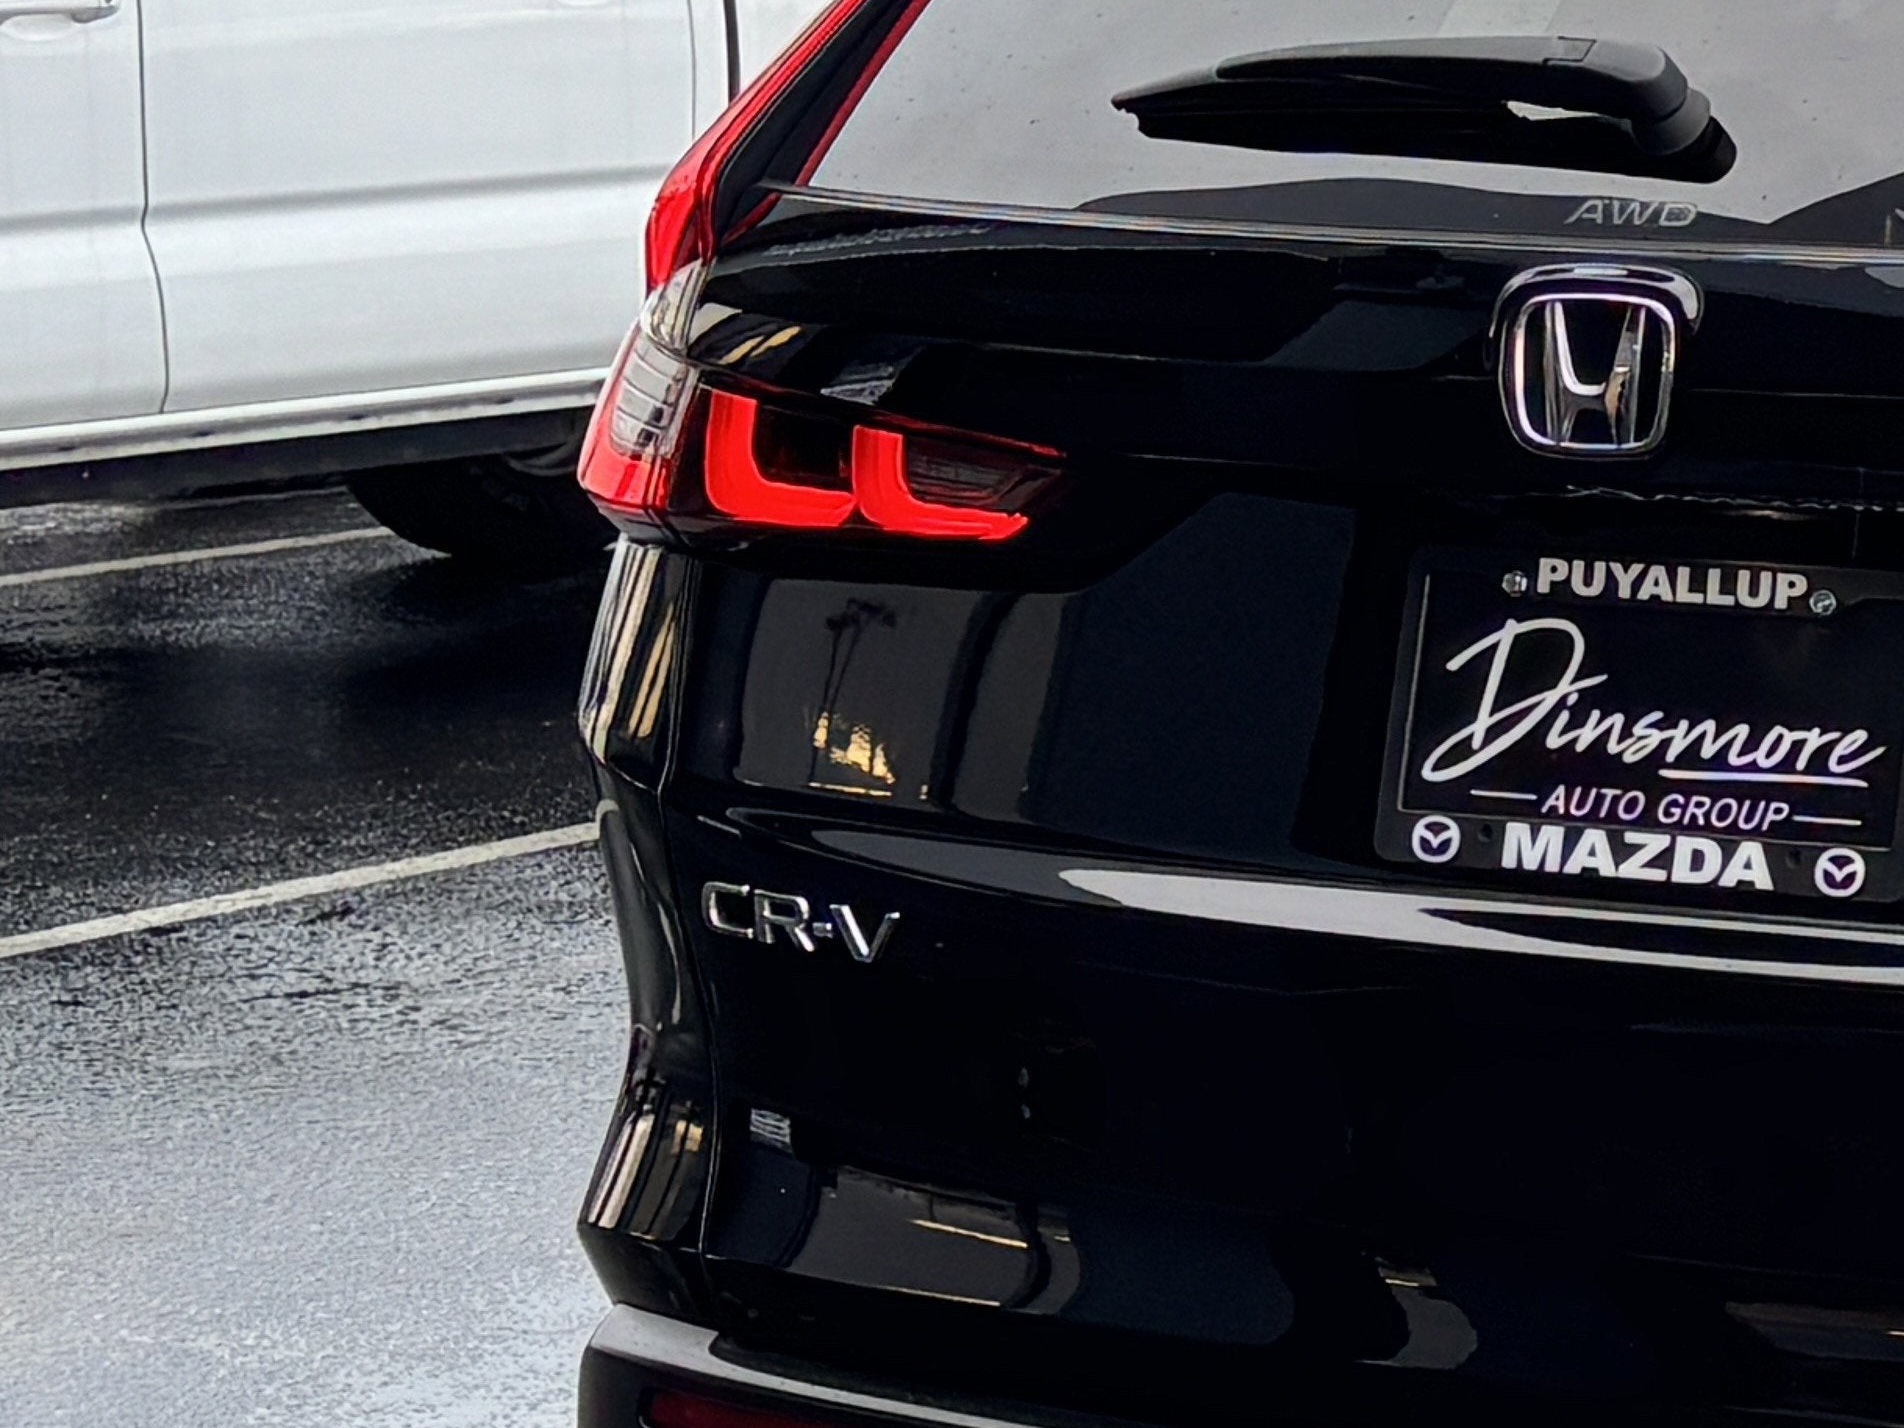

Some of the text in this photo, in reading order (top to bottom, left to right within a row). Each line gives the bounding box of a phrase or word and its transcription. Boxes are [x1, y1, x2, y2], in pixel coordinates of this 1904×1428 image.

[1563, 198, 1698, 228] AWD
[1535, 556, 1808, 611] PUYALLUP
[1420, 617, 1887, 782] Dinsmore
[1540, 784, 1790, 832] AUTO GROUP
[1500, 822, 1775, 892] MAZDA
[701, 881, 900, 963] CR-V
